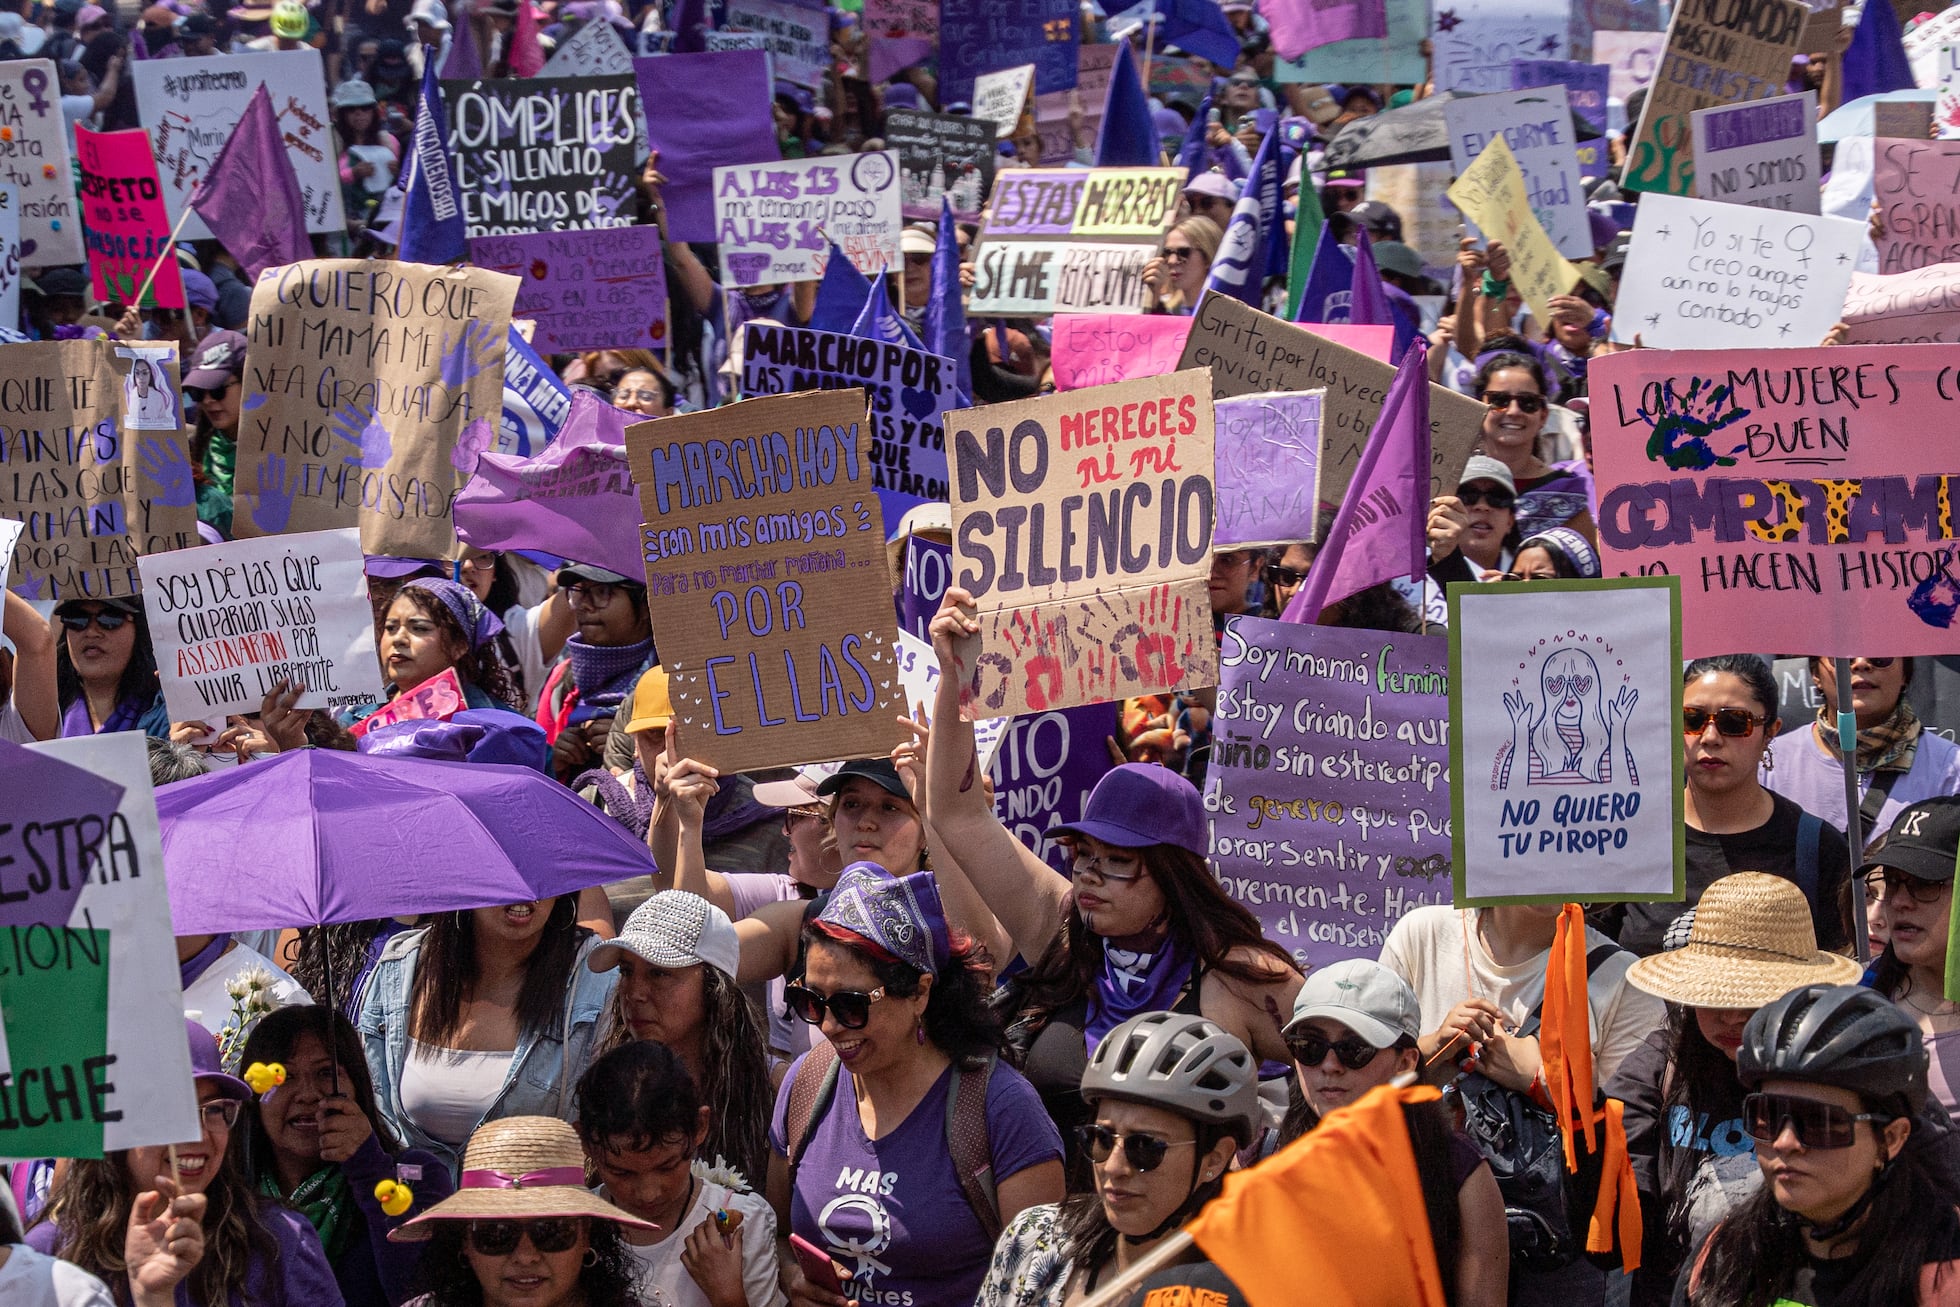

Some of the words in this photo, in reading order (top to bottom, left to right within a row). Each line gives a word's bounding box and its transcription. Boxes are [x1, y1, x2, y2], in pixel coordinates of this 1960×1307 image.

[484, 147, 606, 183] SILENCIO.
[719, 171, 747, 198] A
[804, 166, 840, 195] 13
[1711, 167, 1739, 198] NO
[1745, 154, 1807, 190] SOMOS
[990, 179, 1084, 228] ESTAS
[1080, 175, 1176, 228] MORRAS
[1690, 215, 1716, 252] Yo
[1749, 224, 1775, 259] te
[277, 263, 415, 319] QUIERO
[422, 277, 488, 321] QUE
[1009, 250, 1054, 300] ME
[1698, 278, 1720, 295] no
[1726, 277, 1741, 298] lo
[253, 313, 285, 347] MI
[299, 317, 392, 368] MAMA
[400, 326, 437, 373] ME
[745, 325, 879, 379] MARCHO
[1069, 318, 1153, 354] Estoy
[1199, 294, 1266, 364] Grita
[1270, 344, 1306, 373] por
[1307, 348, 1338, 387] las
[2, 376, 55, 415] QUE
[66, 375, 96, 411] TE
[253, 363, 305, 399] VEA
[316, 366, 474, 424] GRADUADA
[744, 365, 784, 394] LAS
[1727, 363, 1901, 410] MUJERES
[256, 416, 273, 452] Y
[282, 419, 331, 459] NO
[867, 439, 911, 471] QUE
[954, 418, 1050, 504] NO
[1059, 394, 1198, 452] MERECES
[1744, 415, 1851, 460] BUEN
[14, 466, 69, 504] LAS
[76, 465, 137, 501] QUE
[651, 430, 795, 515] MARCHO
[795, 422, 860, 489] HOY
[1076, 442, 1124, 489] ni
[1129, 436, 1183, 479] mi
[658, 524, 694, 556] con
[698, 513, 750, 554] mis
[755, 503, 847, 544] amigas
[957, 473, 1214, 600] SILENCIO
[14, 542, 82, 575] POR
[652, 570, 690, 597] Para
[693, 567, 717, 590] no
[720, 557, 778, 588] marchar
[1701, 552, 1824, 594] HACEN
[156, 572, 203, 613] SOY
[710, 579, 806, 641] POR
[176, 629, 289, 679] ASESINARAN
[292, 626, 321, 659] POR
[1221, 615, 1281, 683] Soy
[1284, 646, 1370, 686] mamá
[194, 672, 248, 707] VIVIR
[705, 633, 877, 737] ELLAS
[1214, 681, 1285, 740] estoy
[1209, 729, 1272, 771] niño
[1274, 744, 1316, 778] sin
[1202, 776, 1238, 815] de
[1351, 805, 1399, 842] que
[1500, 798, 1541, 828] NO
[1552, 791, 1641, 825] QUIERO
[1900, 810, 1931, 837] K
[1497, 831, 1532, 858] TU
[1538, 827, 1629, 856] PIROPO
[1376, 853, 1393, 881] y
[1275, 909, 1300, 937] el
[835, 1166, 899, 1196] MAS
